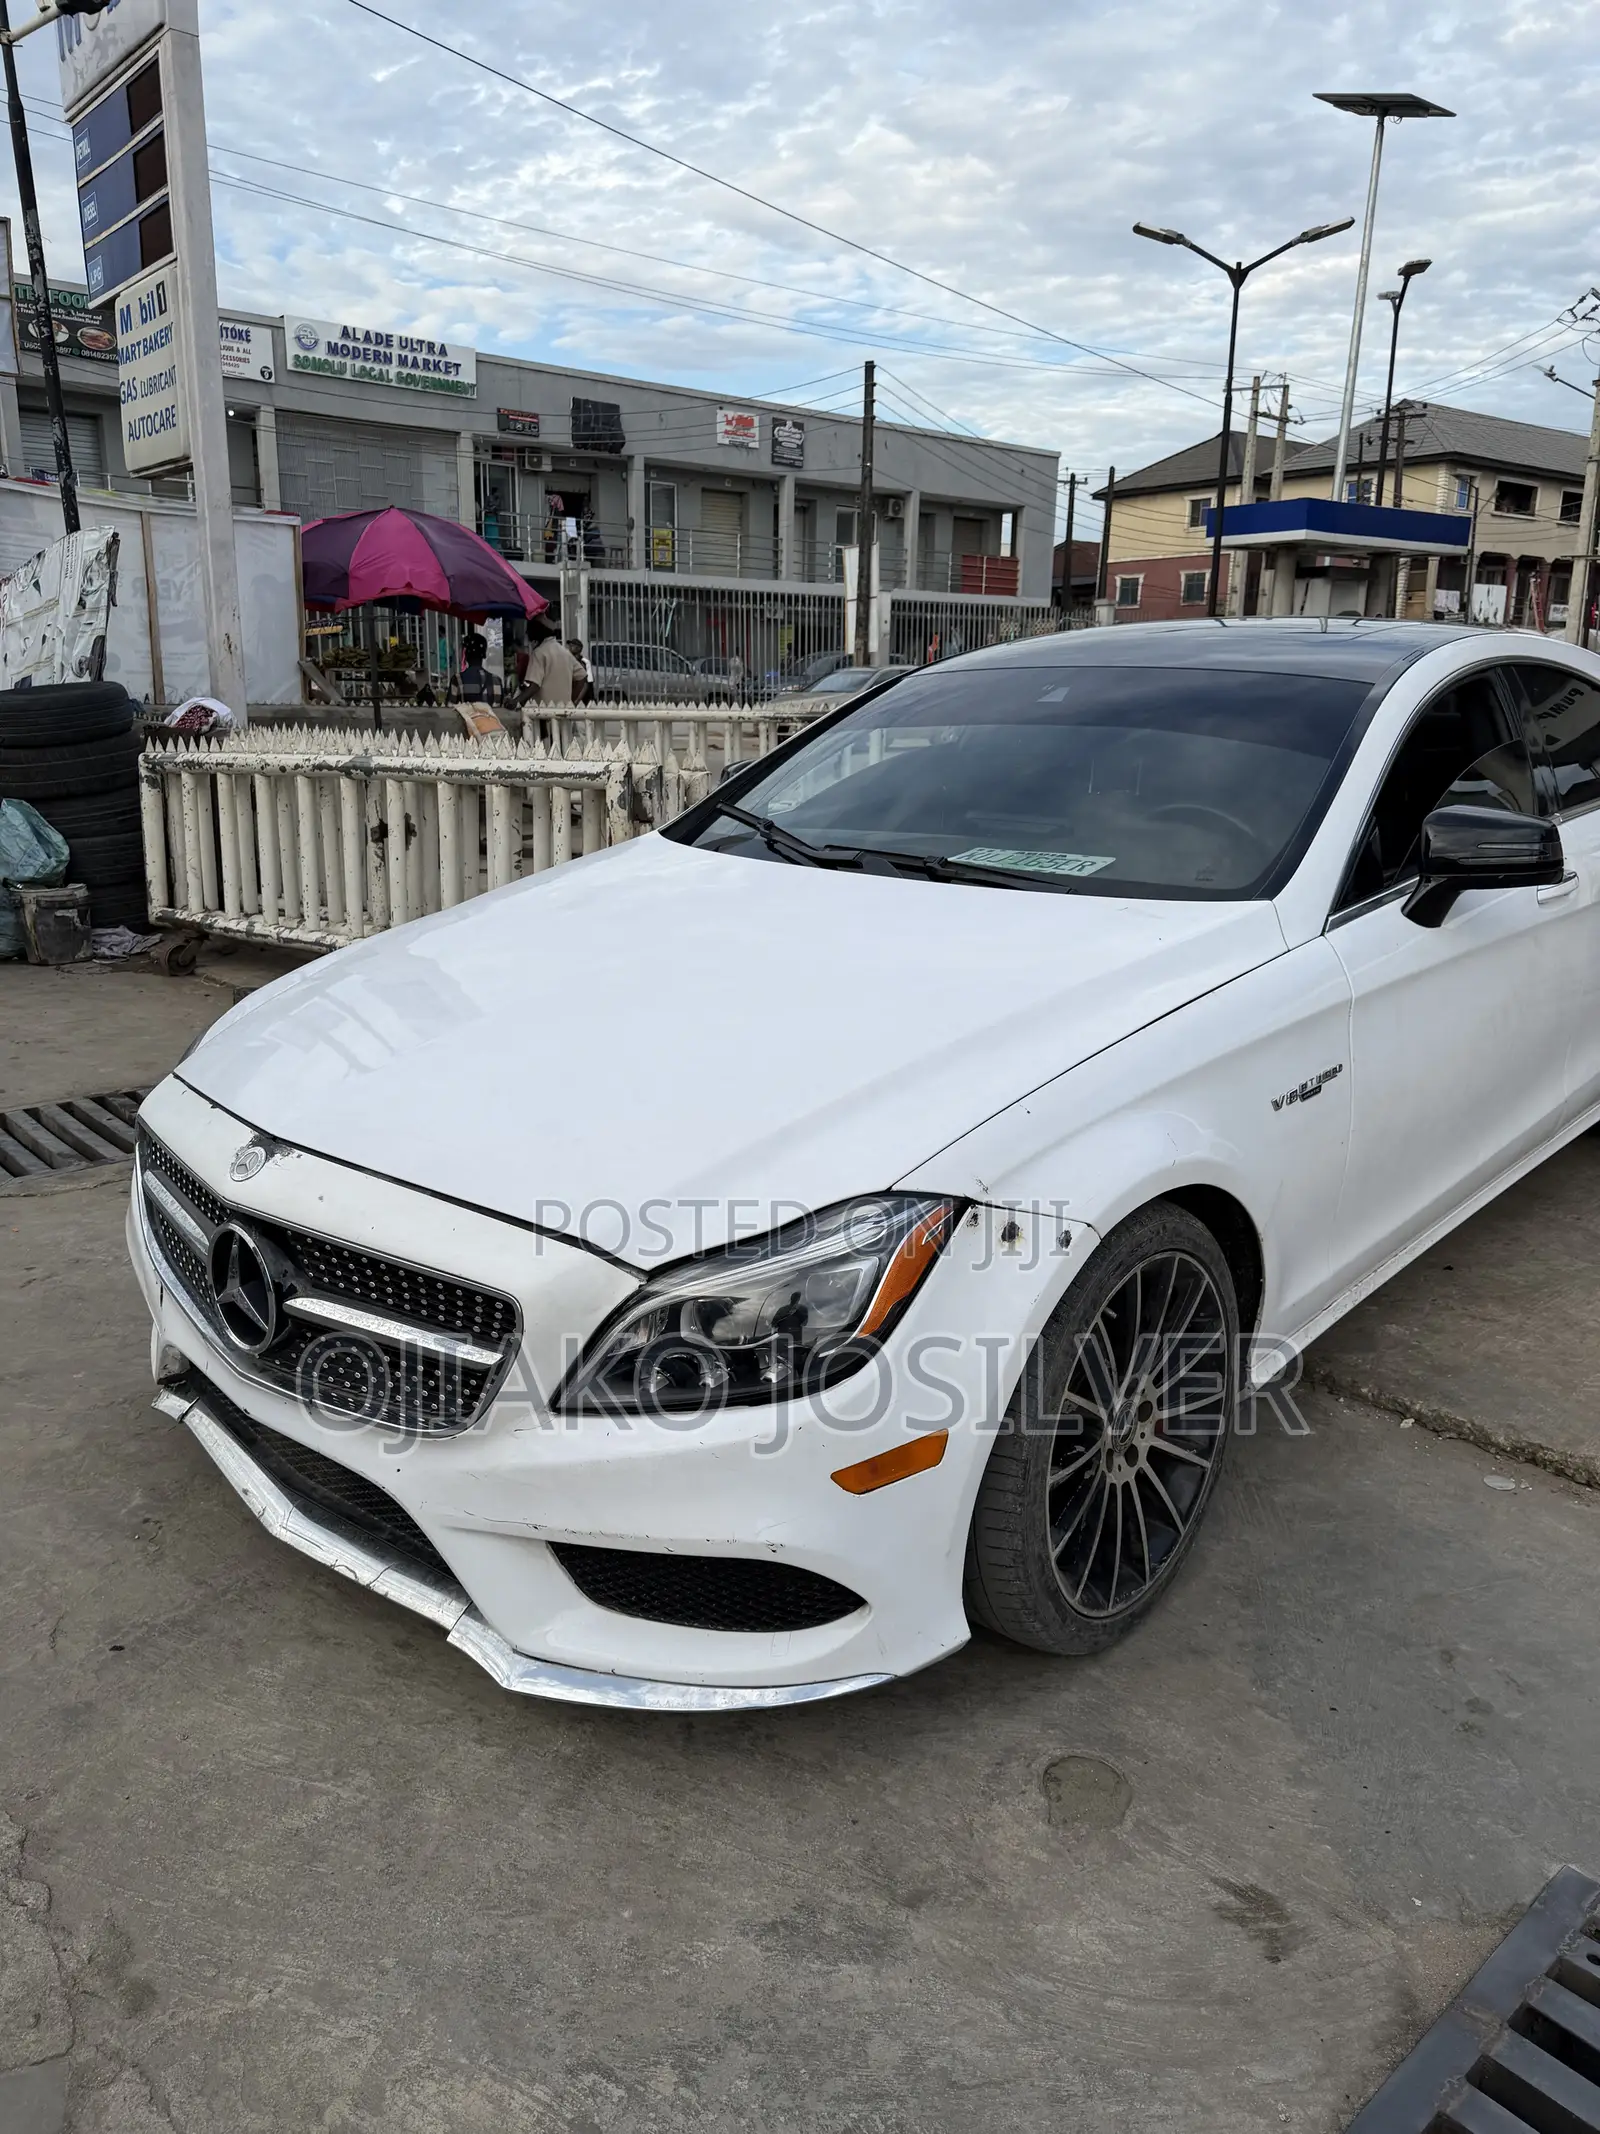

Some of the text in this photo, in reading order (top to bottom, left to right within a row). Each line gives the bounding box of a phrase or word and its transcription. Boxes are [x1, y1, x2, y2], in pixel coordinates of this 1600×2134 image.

[89, 267, 102, 285] LPG
[119, 290, 157, 335] Mbil
[118, 321, 174, 366] MART BAKERY
[326, 341, 462, 377] MODERN MARKET
[340, 325, 448, 358] ALADE ULTRA
[119, 364, 177, 405] GAS LUBRICANT
[293, 354, 477, 397] SOMOLU LOCAL GOVERNMENT
[128, 404, 177, 443] AUTOCARE
